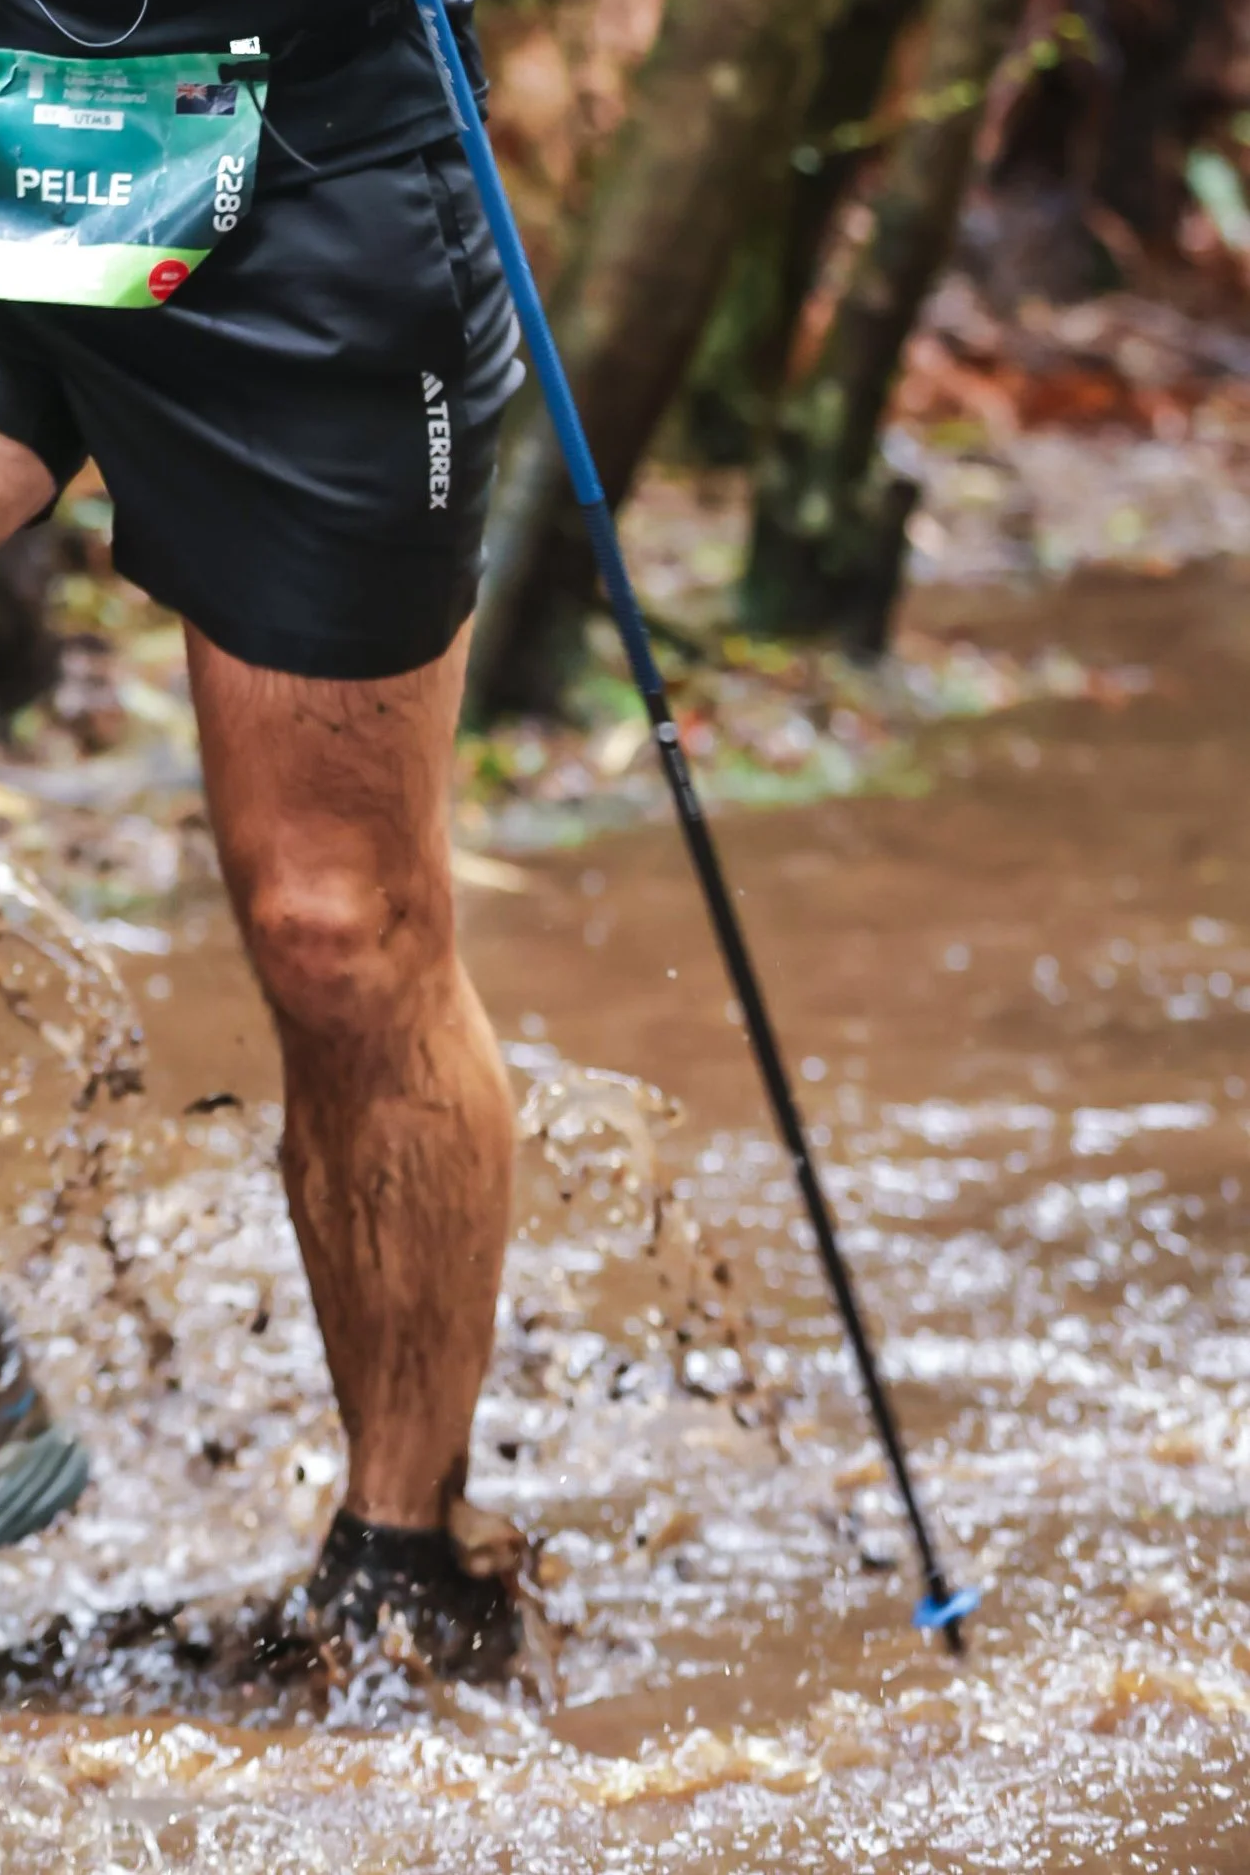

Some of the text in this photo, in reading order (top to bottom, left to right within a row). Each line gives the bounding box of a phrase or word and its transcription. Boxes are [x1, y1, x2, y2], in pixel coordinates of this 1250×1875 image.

[16, 167, 133, 206] PELLE
[213, 155, 245, 232] 2289
[426, 399, 452, 509] TERREX
